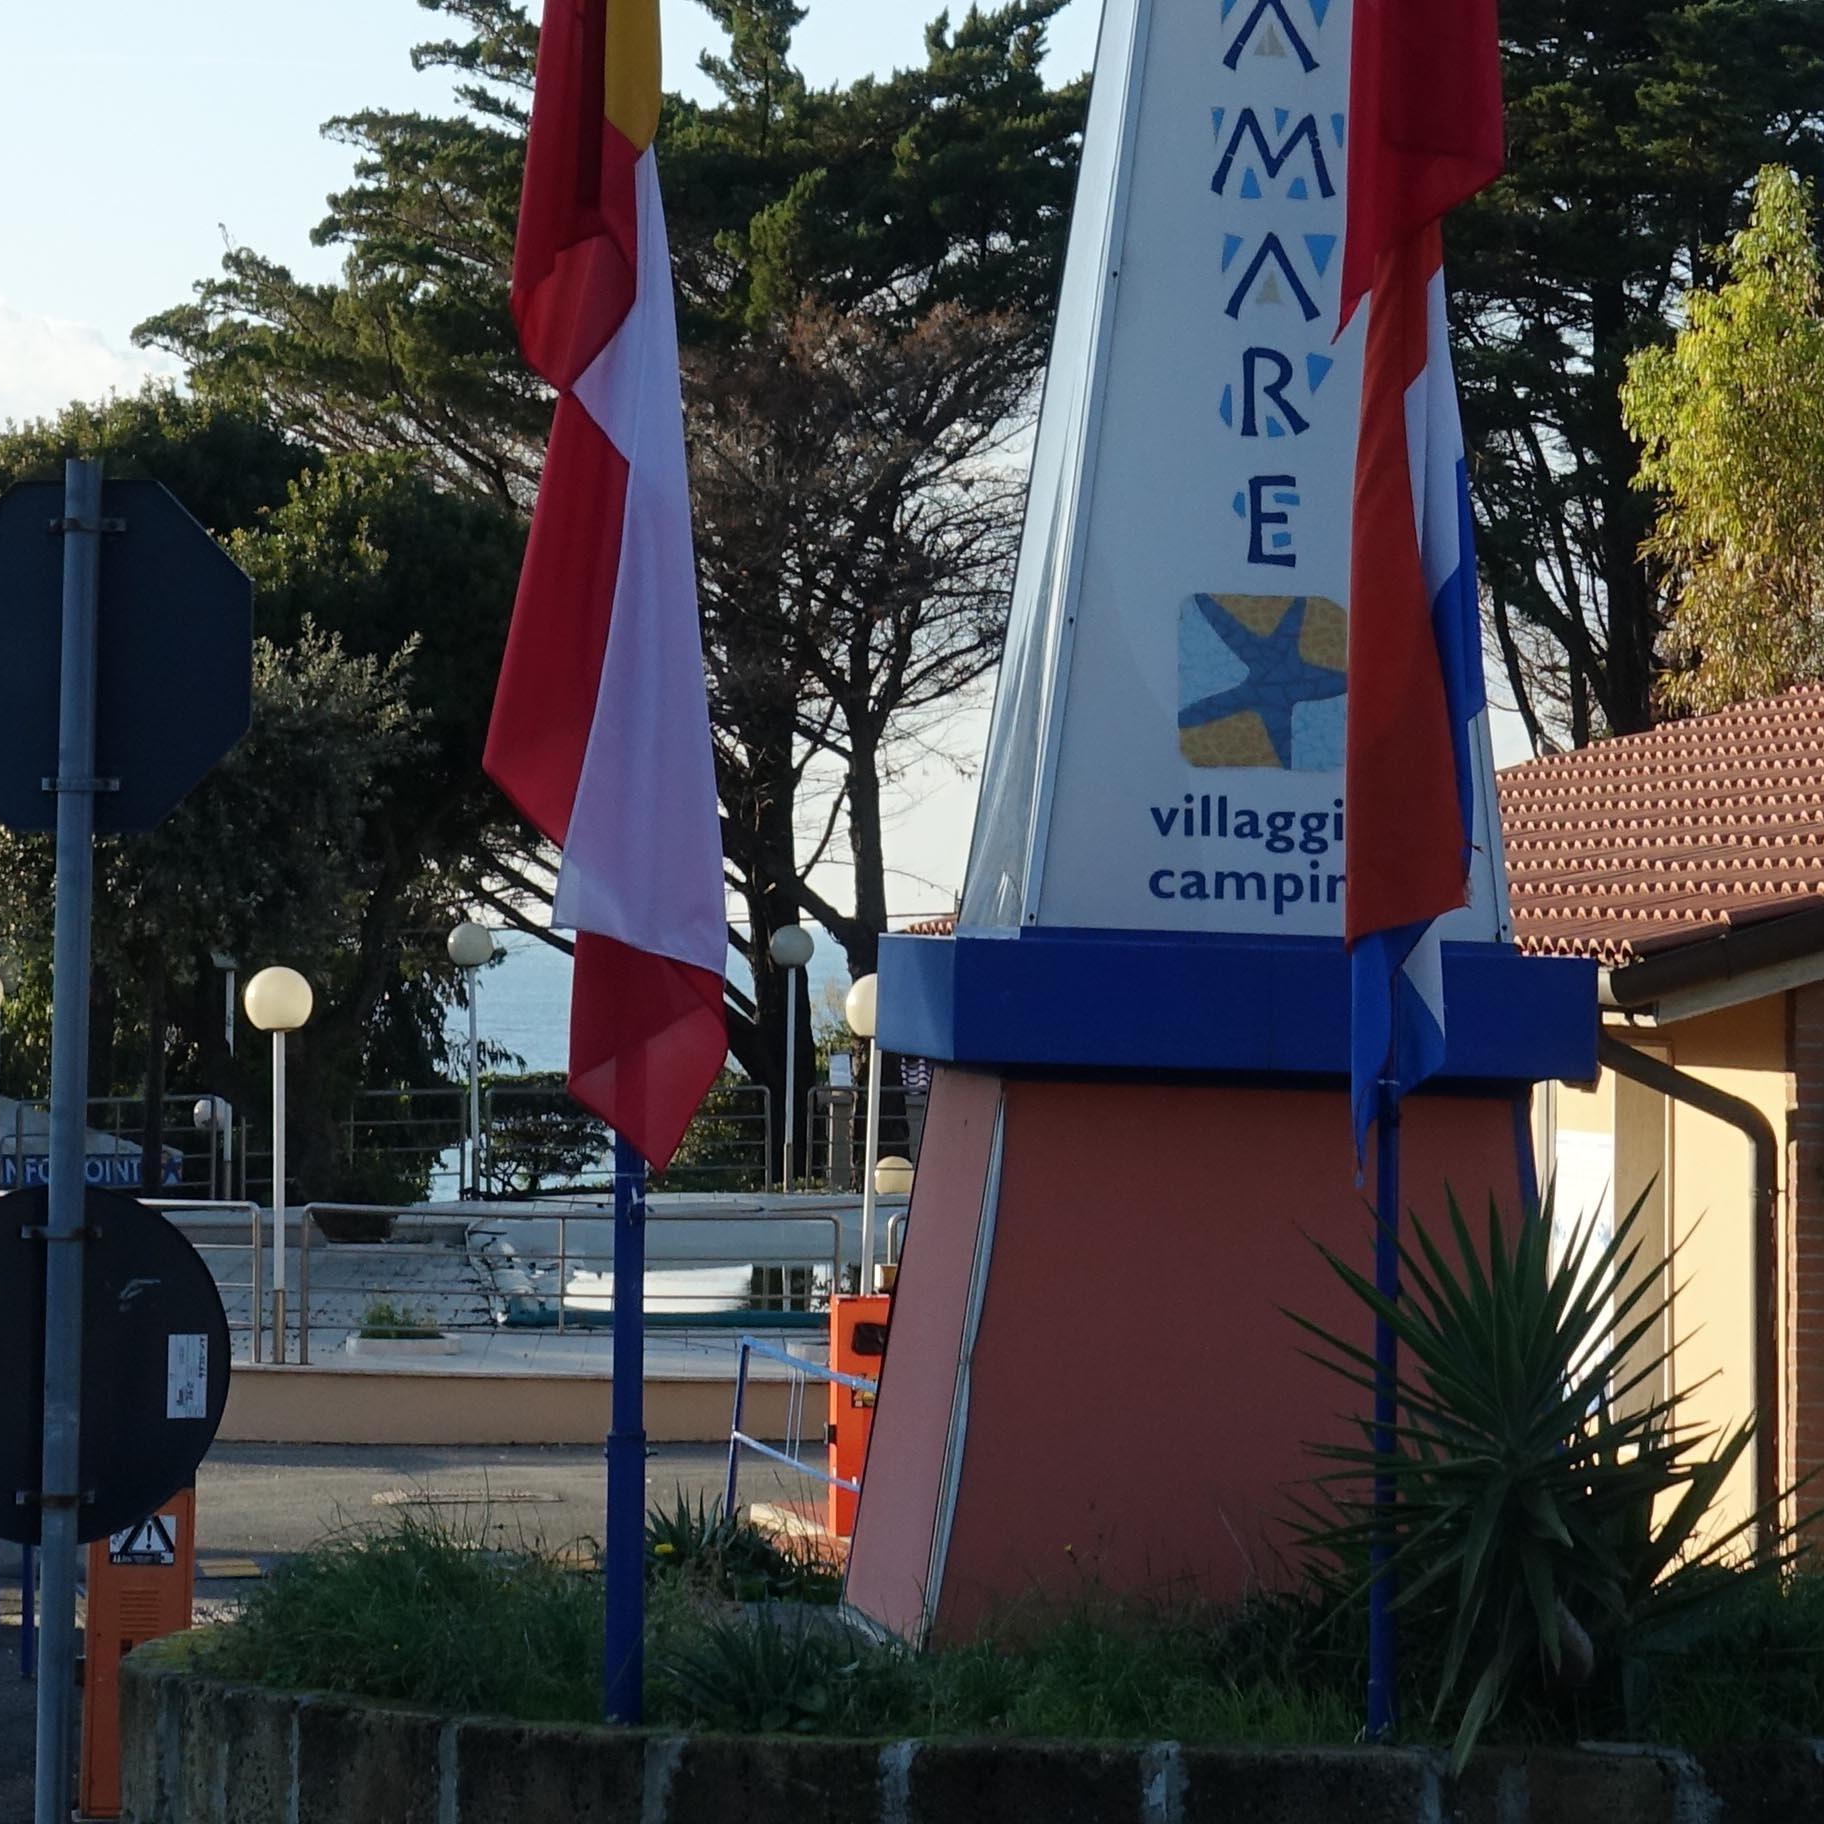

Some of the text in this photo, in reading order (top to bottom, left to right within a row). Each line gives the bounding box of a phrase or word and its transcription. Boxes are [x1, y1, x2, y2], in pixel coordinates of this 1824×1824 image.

[1150, 794, 1344, 854] villaggi
[1149, 860, 1346, 915] campin
[85, 1158, 141, 1183] OINT
